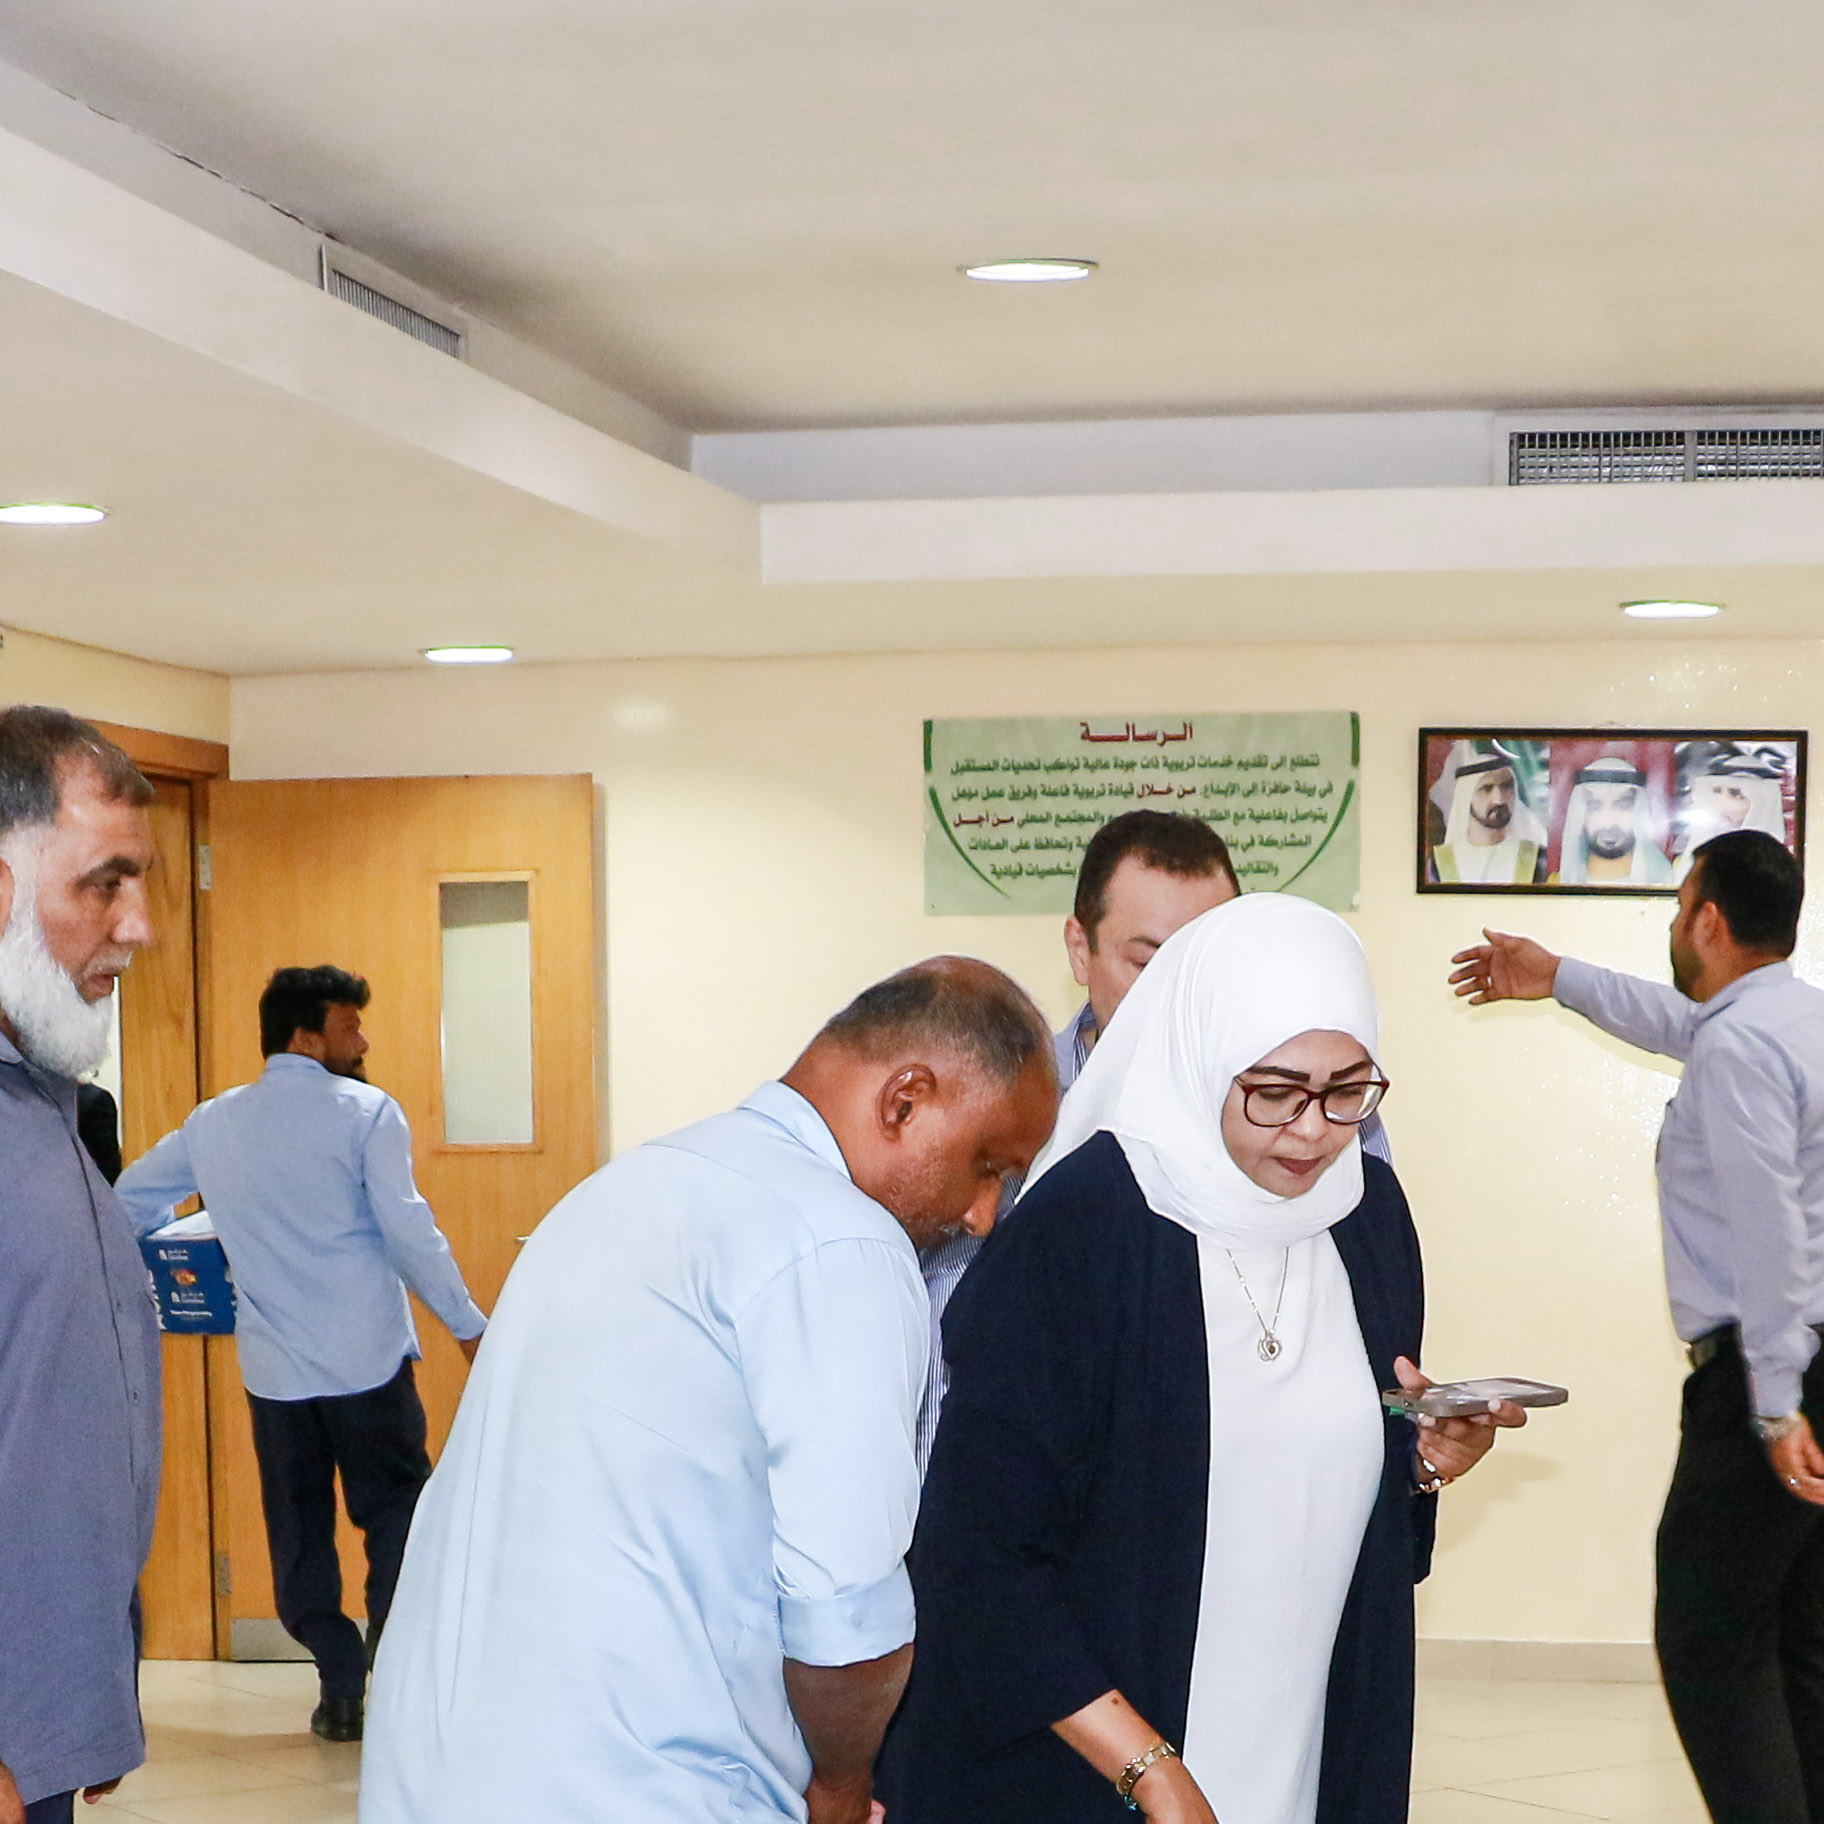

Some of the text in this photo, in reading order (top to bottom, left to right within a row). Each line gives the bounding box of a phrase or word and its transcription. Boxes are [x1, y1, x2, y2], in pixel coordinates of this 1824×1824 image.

[1080, 721, 1193, 747] الرسالة
[950, 759, 999, 775] المستقبل
[1083, 757, 1110, 772] عالية
[1113, 757, 1137, 772] جودة
[1141, 757, 1159, 769] ذات
[1162, 756, 1196, 771] تربوية
[1137, 782, 1174, 799] خلال
[1177, 784, 1196, 799] من
[992, 814, 1015, 828] من
